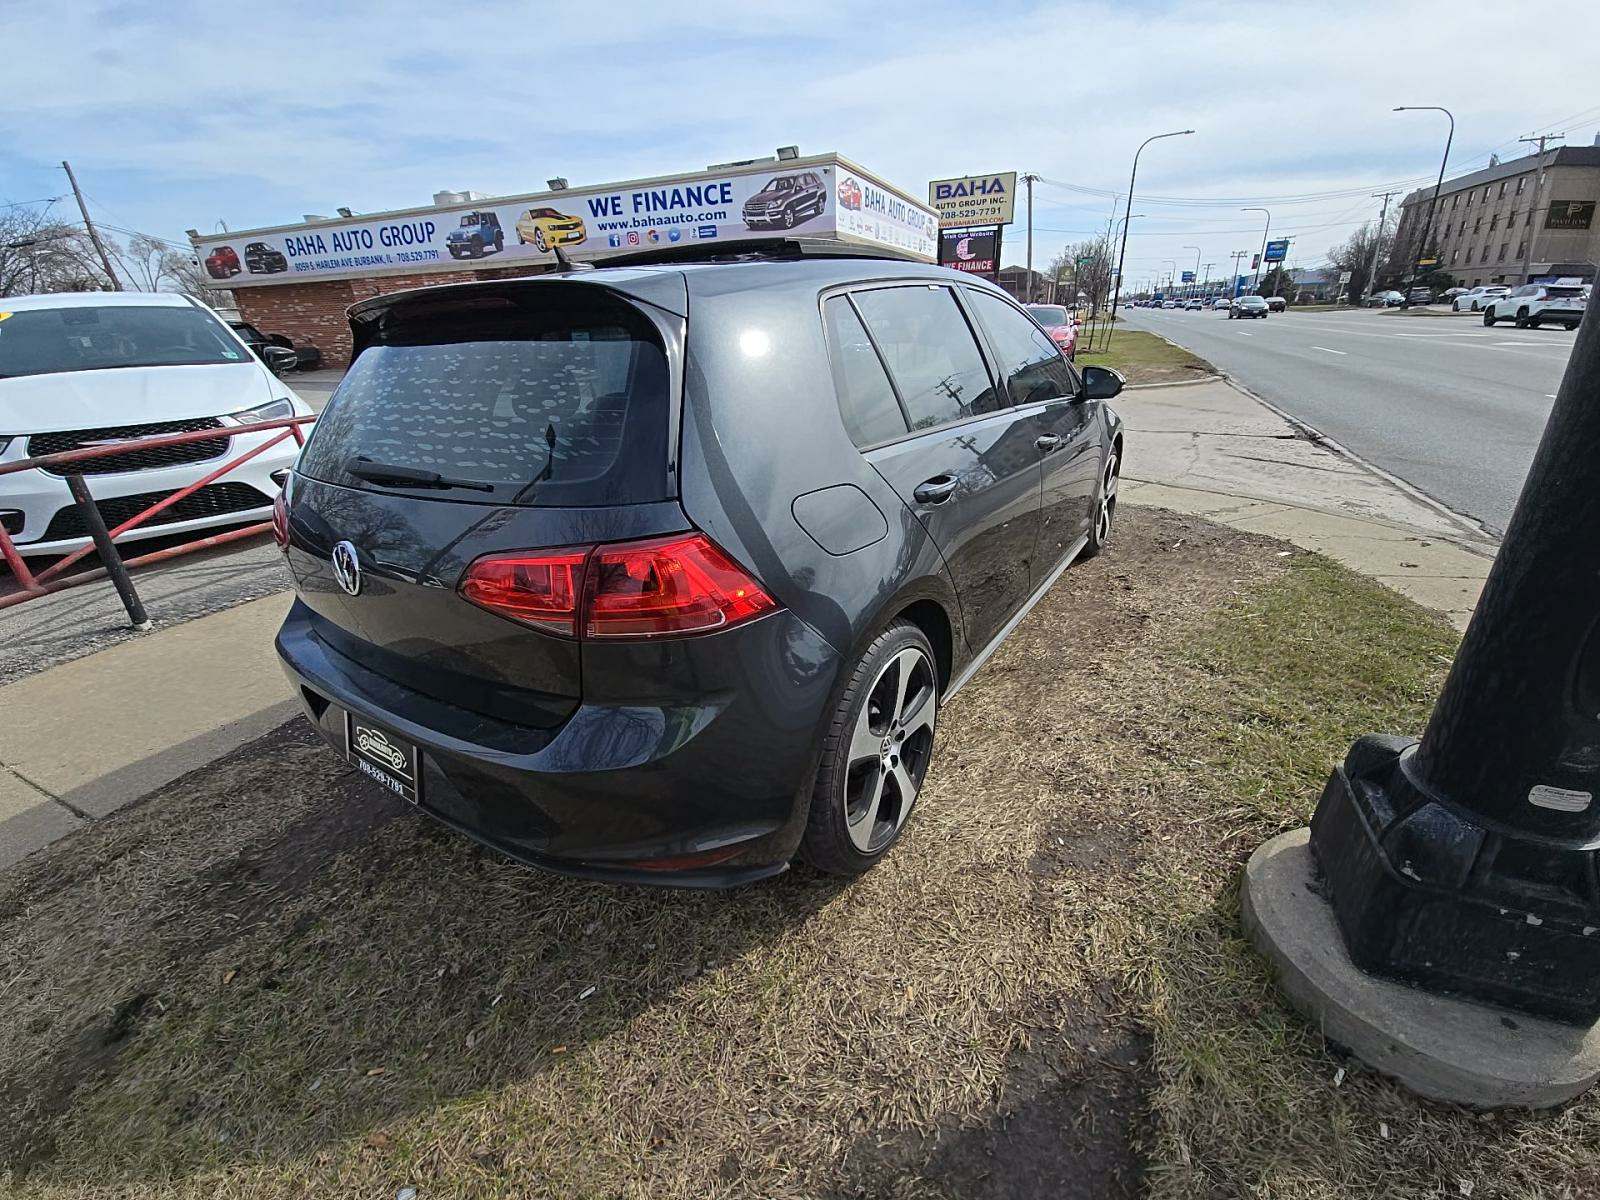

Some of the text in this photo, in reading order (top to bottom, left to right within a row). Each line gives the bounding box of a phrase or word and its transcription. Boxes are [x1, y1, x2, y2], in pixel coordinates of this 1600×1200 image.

[936, 178, 1004, 199] BAHA
[587, 182, 734, 218] WE FINANCE
[865, 187, 886, 215] BAHA
[888, 199, 906, 222] AUTO
[907, 208, 926, 230] GROUP
[935, 196, 1007, 210] AUTO GROUP INC.
[598, 210, 727, 230] www.bahaauto.com
[940, 206, 1001, 220] 708-529-7791
[285, 222, 435, 257] BAHA AUTO GROUP
[315, 259, 341, 270] HARLEM
[340, 257, 354, 268] AVE
[396, 249, 440, 263] 708.529.7791
[957, 259, 993, 271] FINANCE
[359, 758, 404, 795] 708-529-7791
